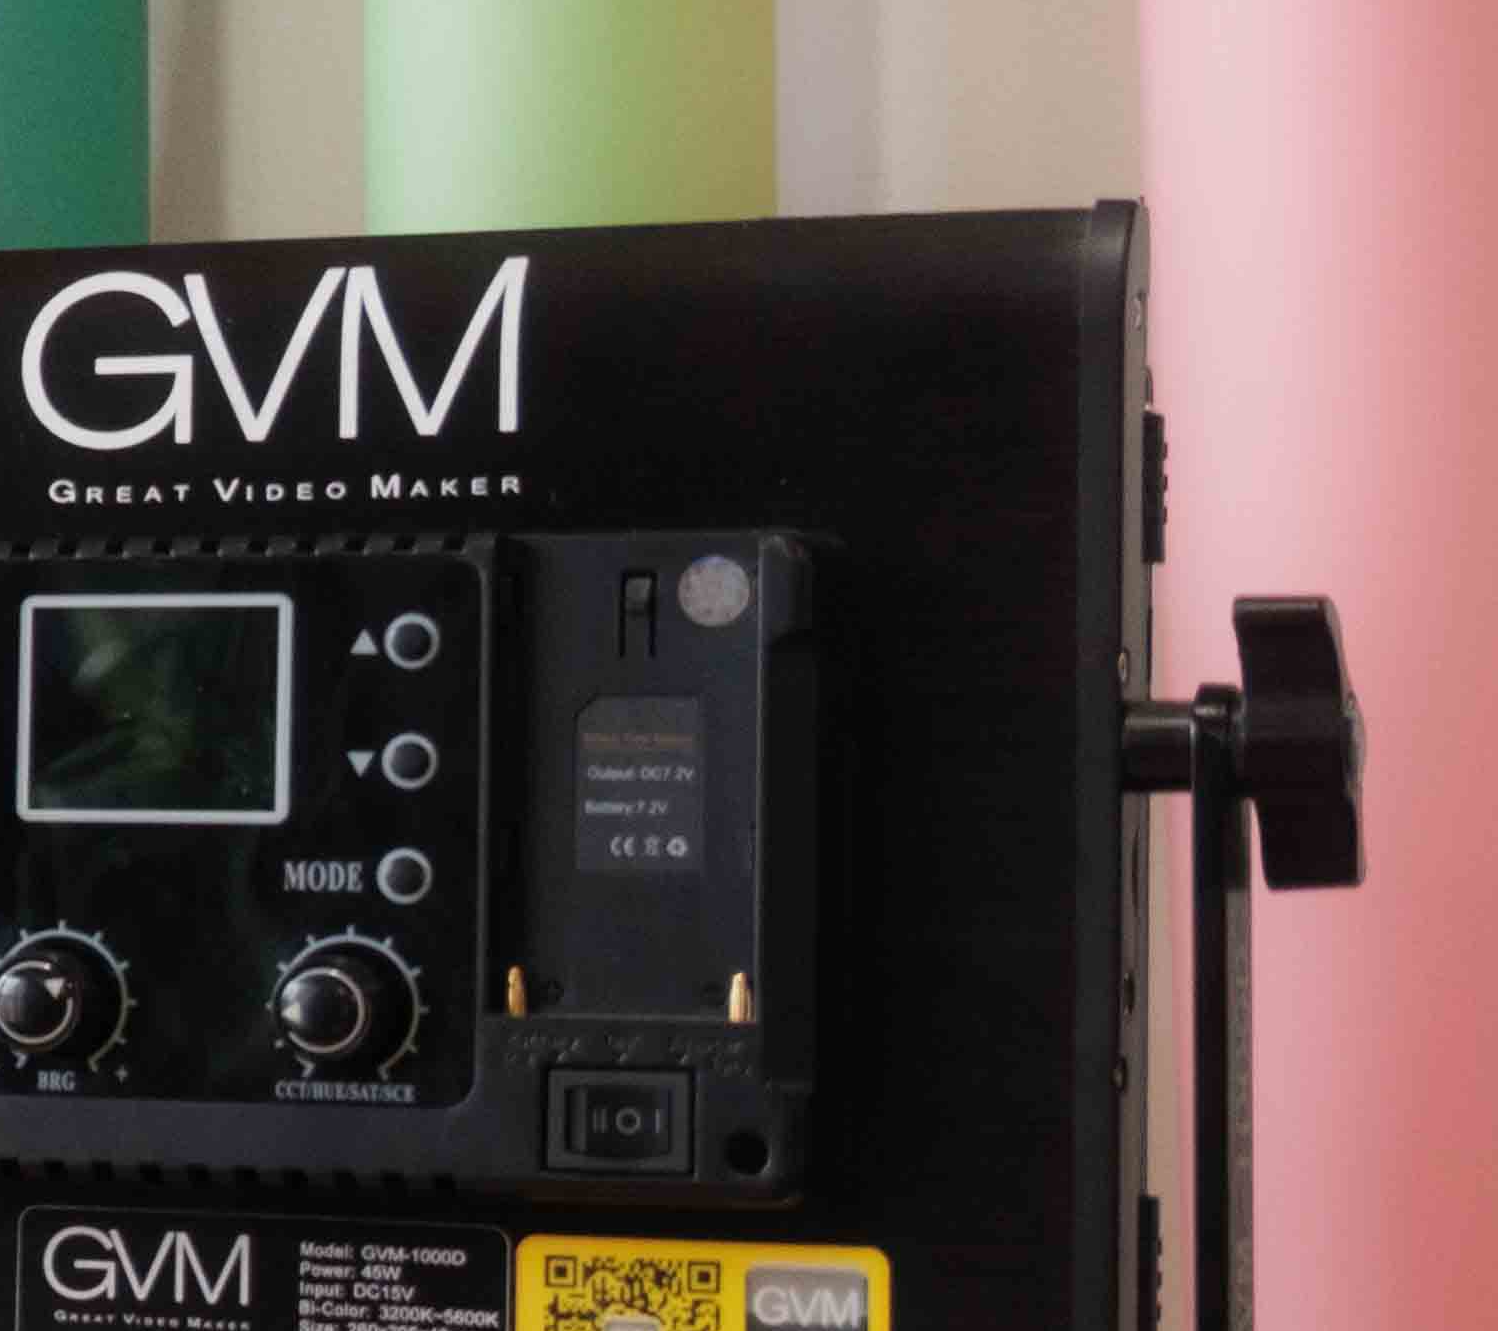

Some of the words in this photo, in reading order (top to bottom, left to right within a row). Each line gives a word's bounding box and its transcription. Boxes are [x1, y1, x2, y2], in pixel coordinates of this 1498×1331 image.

[20, 255, 529, 451] GVM
[283, 860, 364, 893] MODE
[37, 1070, 76, 1092] BRG
[43, 1225, 250, 1307] GVM
[299, 1242, 354, 1261] Model:
[361, 1245, 466, 1267] GVM-1000D
[299, 1261, 355, 1279] Power:
[361, 1265, 402, 1281] 45W
[299, 1281, 346, 1299] Input:
[353, 1283, 416, 1302] DC15V
[298, 1300, 371, 1319] Bi-Color:
[752, 1285, 859, 1329] GVM
